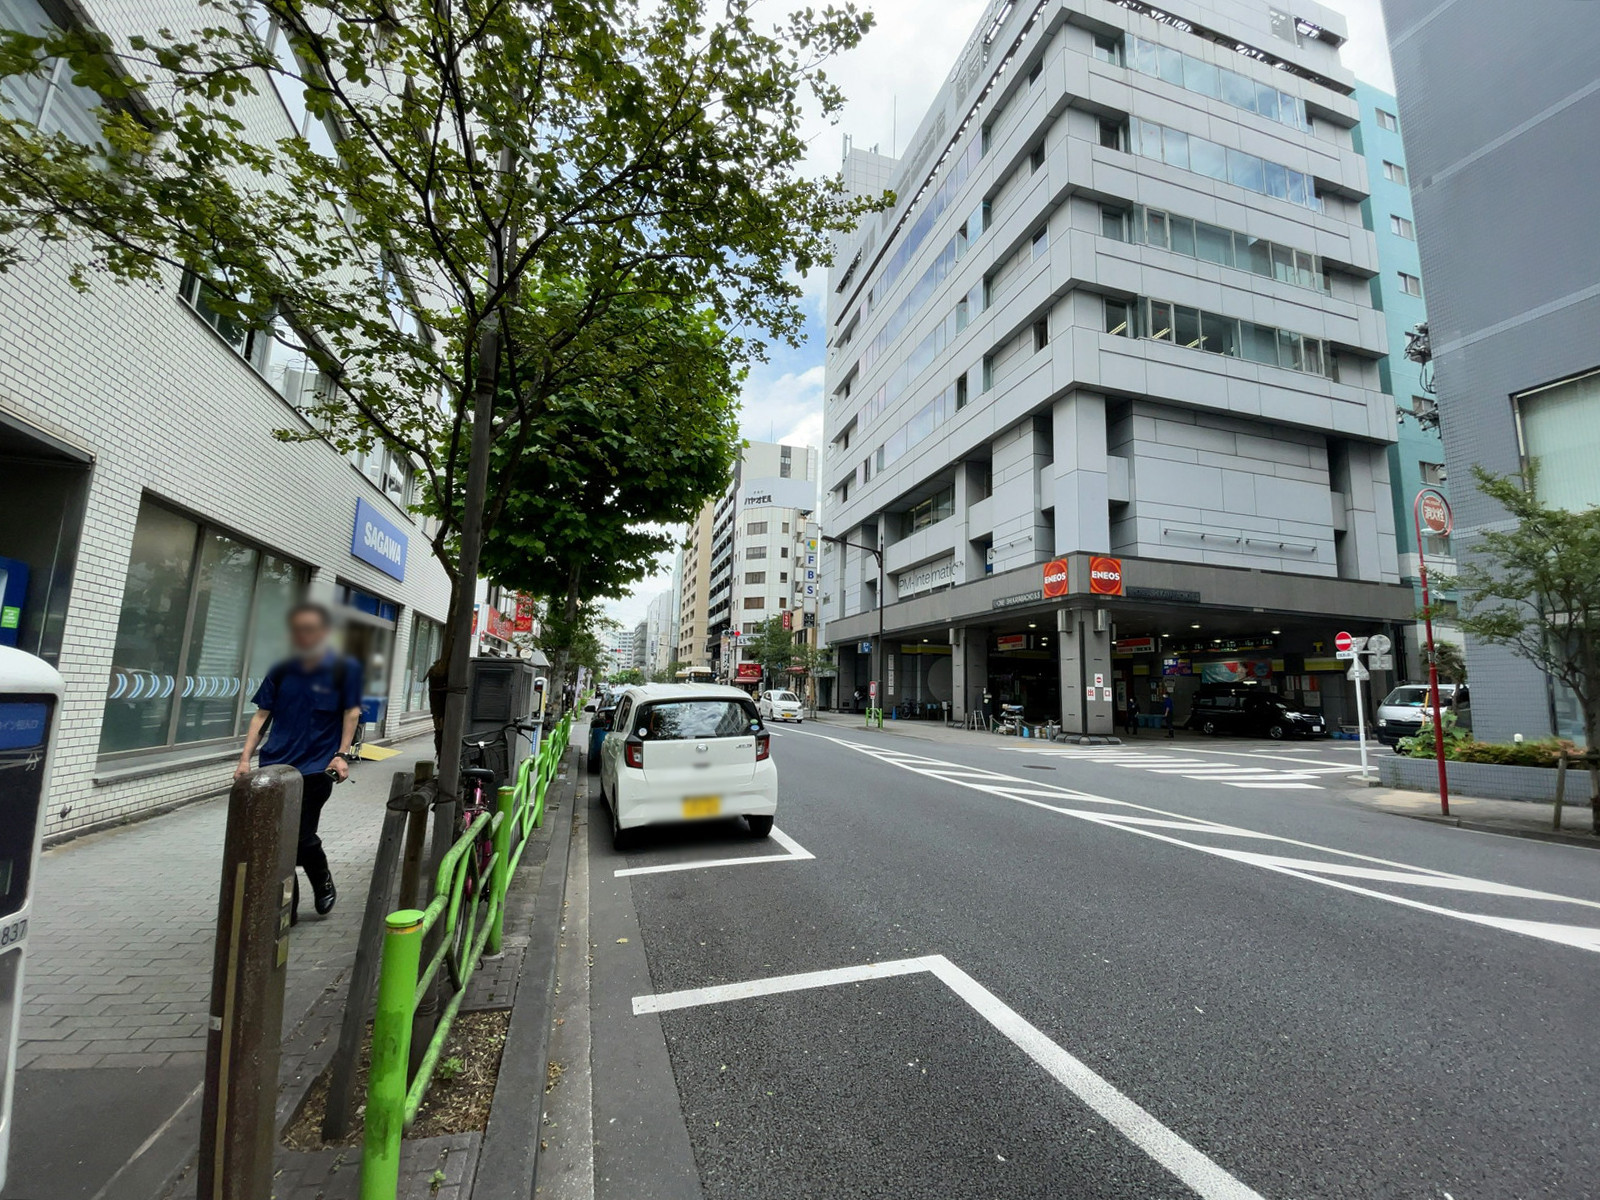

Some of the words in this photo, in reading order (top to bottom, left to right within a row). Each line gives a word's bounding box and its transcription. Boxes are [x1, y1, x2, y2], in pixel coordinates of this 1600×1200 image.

[364, 521, 401, 565] SAGAWA
[1044, 572, 1066, 584] ENEOS
[1091, 570, 1120, 581] ENEOS
[25, 752, 43, 772] 分
[1, 919, 27, 946] 837
